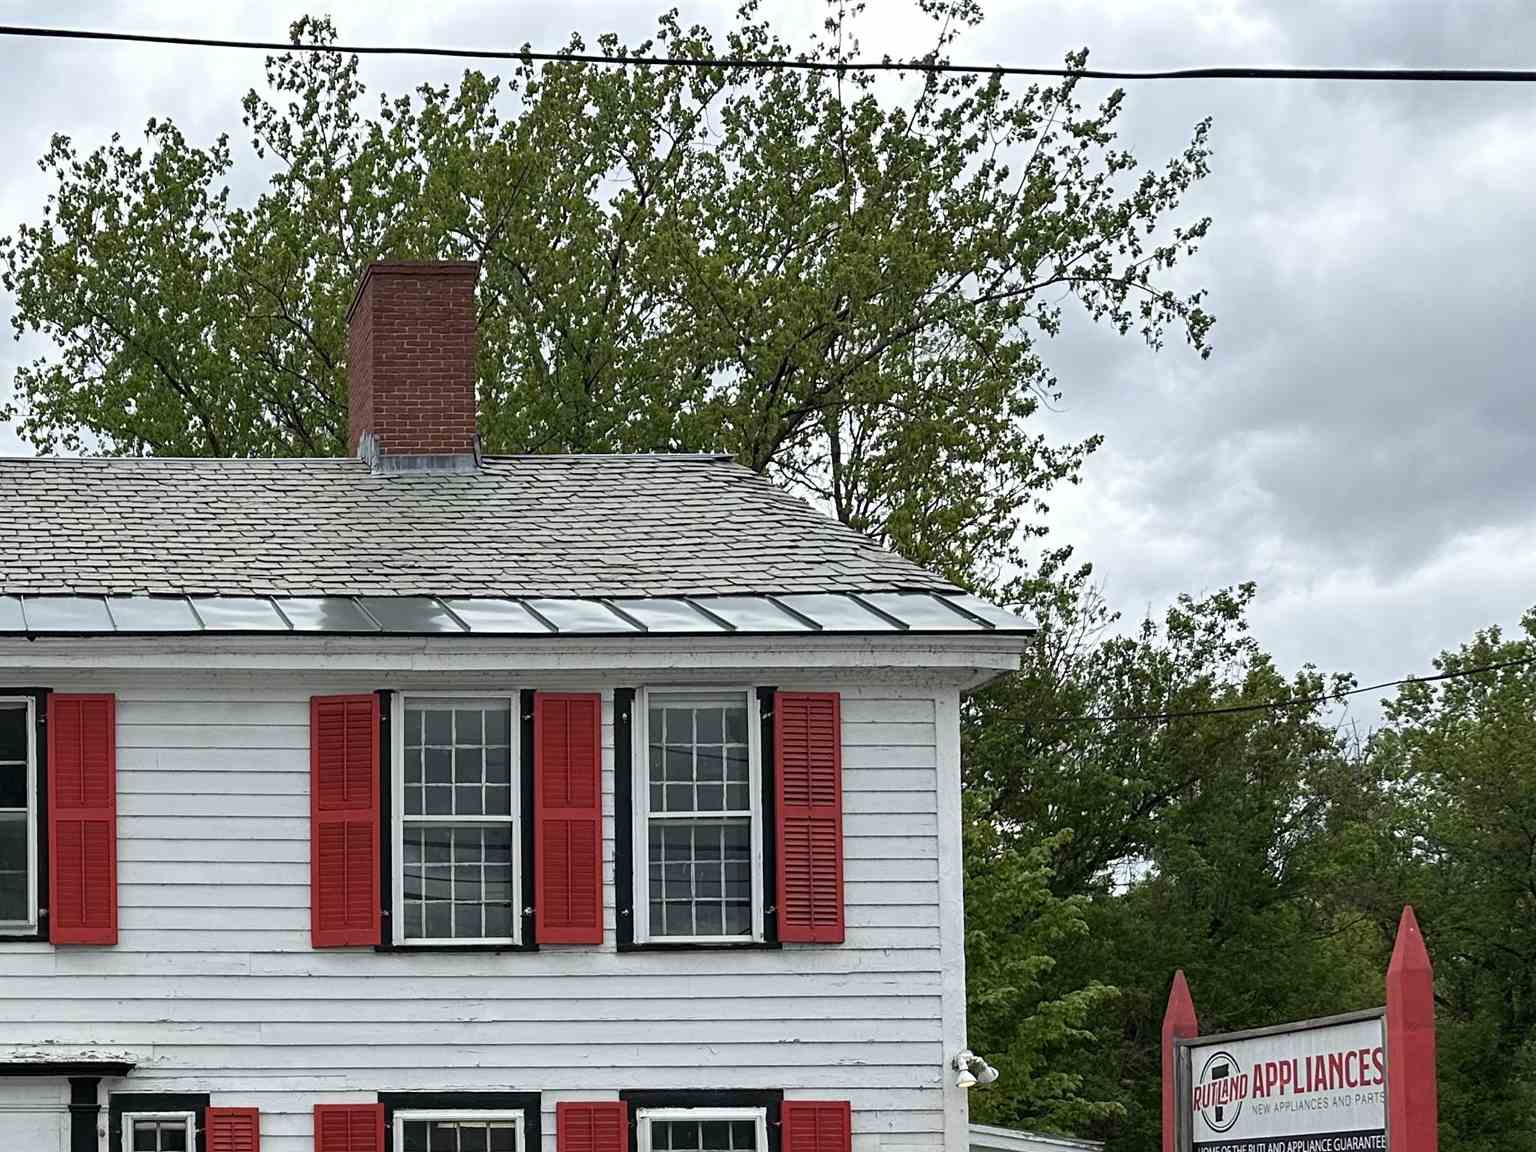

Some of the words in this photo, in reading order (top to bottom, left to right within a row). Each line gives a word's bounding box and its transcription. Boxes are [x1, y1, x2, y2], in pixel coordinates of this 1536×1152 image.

[1193, 1073, 1248, 1111] RUTLAND
[1252, 1047, 1385, 1099] APPLIANCES
[1252, 1104, 1271, 1115] NEW
[1274, 1097, 1328, 1113] APPLIANCES
[1333, 1094, 1352, 1107] AND
[1355, 1091, 1385, 1105] PARTS
[1333, 1135, 1386, 1152] GUARANTEE
